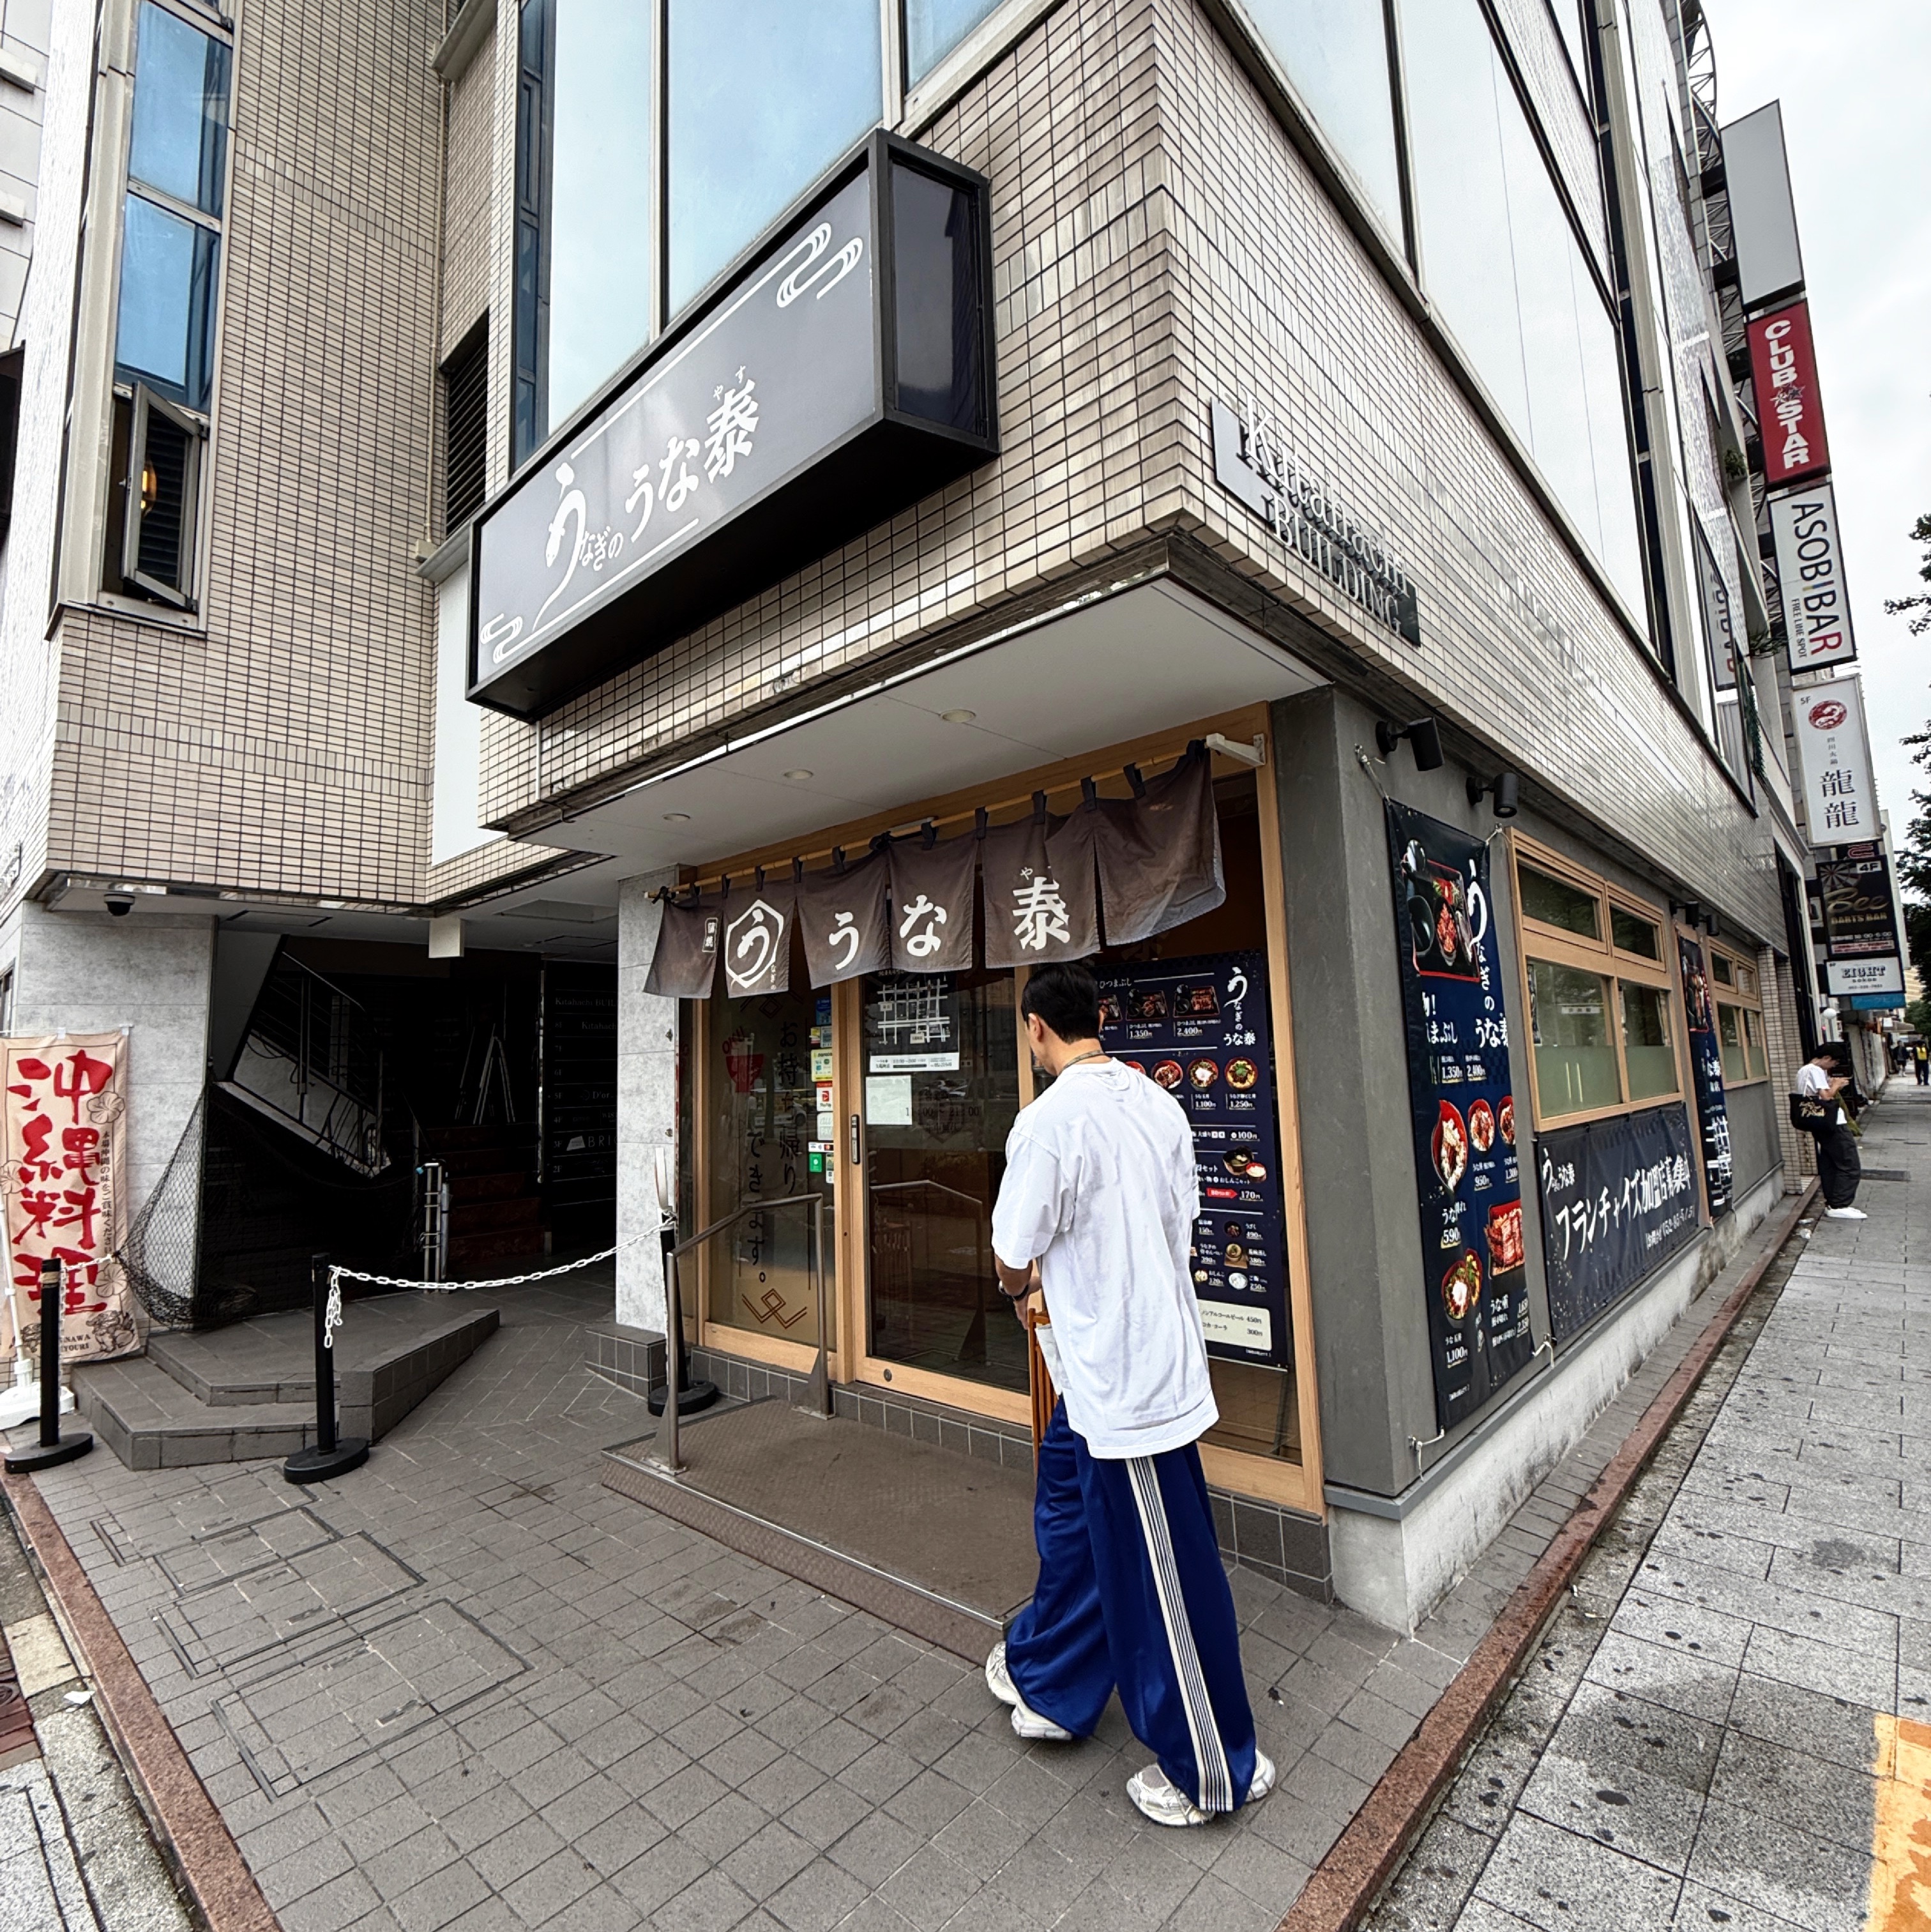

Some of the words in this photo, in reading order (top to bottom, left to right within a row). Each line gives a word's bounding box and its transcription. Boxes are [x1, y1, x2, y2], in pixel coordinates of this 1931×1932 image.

[1764, 319, 1797, 388] CLUB
[1776, 400, 1810, 469] STAR
[625, 378, 760, 543] うな泰
[1271, 491, 1402, 639] BUILDING
[1791, 598, 1802, 618] FREE
[1796, 637, 1807, 658] SPOT
[1820, 769, 1860, 829] 龍龍
[1859, 863, 1879, 871] 4F
[829, 876, 1071, 971] うな泰
[1831, 915, 1865, 925] DARTS
[1866, 912, 1888, 922] BAR
[1841, 966, 1886, 978] EIGHT
[1223, 1032, 1256, 1046] うな泰
[8, 1049, 114, 1315] 沖縄料理
[1241, 1190, 1261, 1199] 170円
